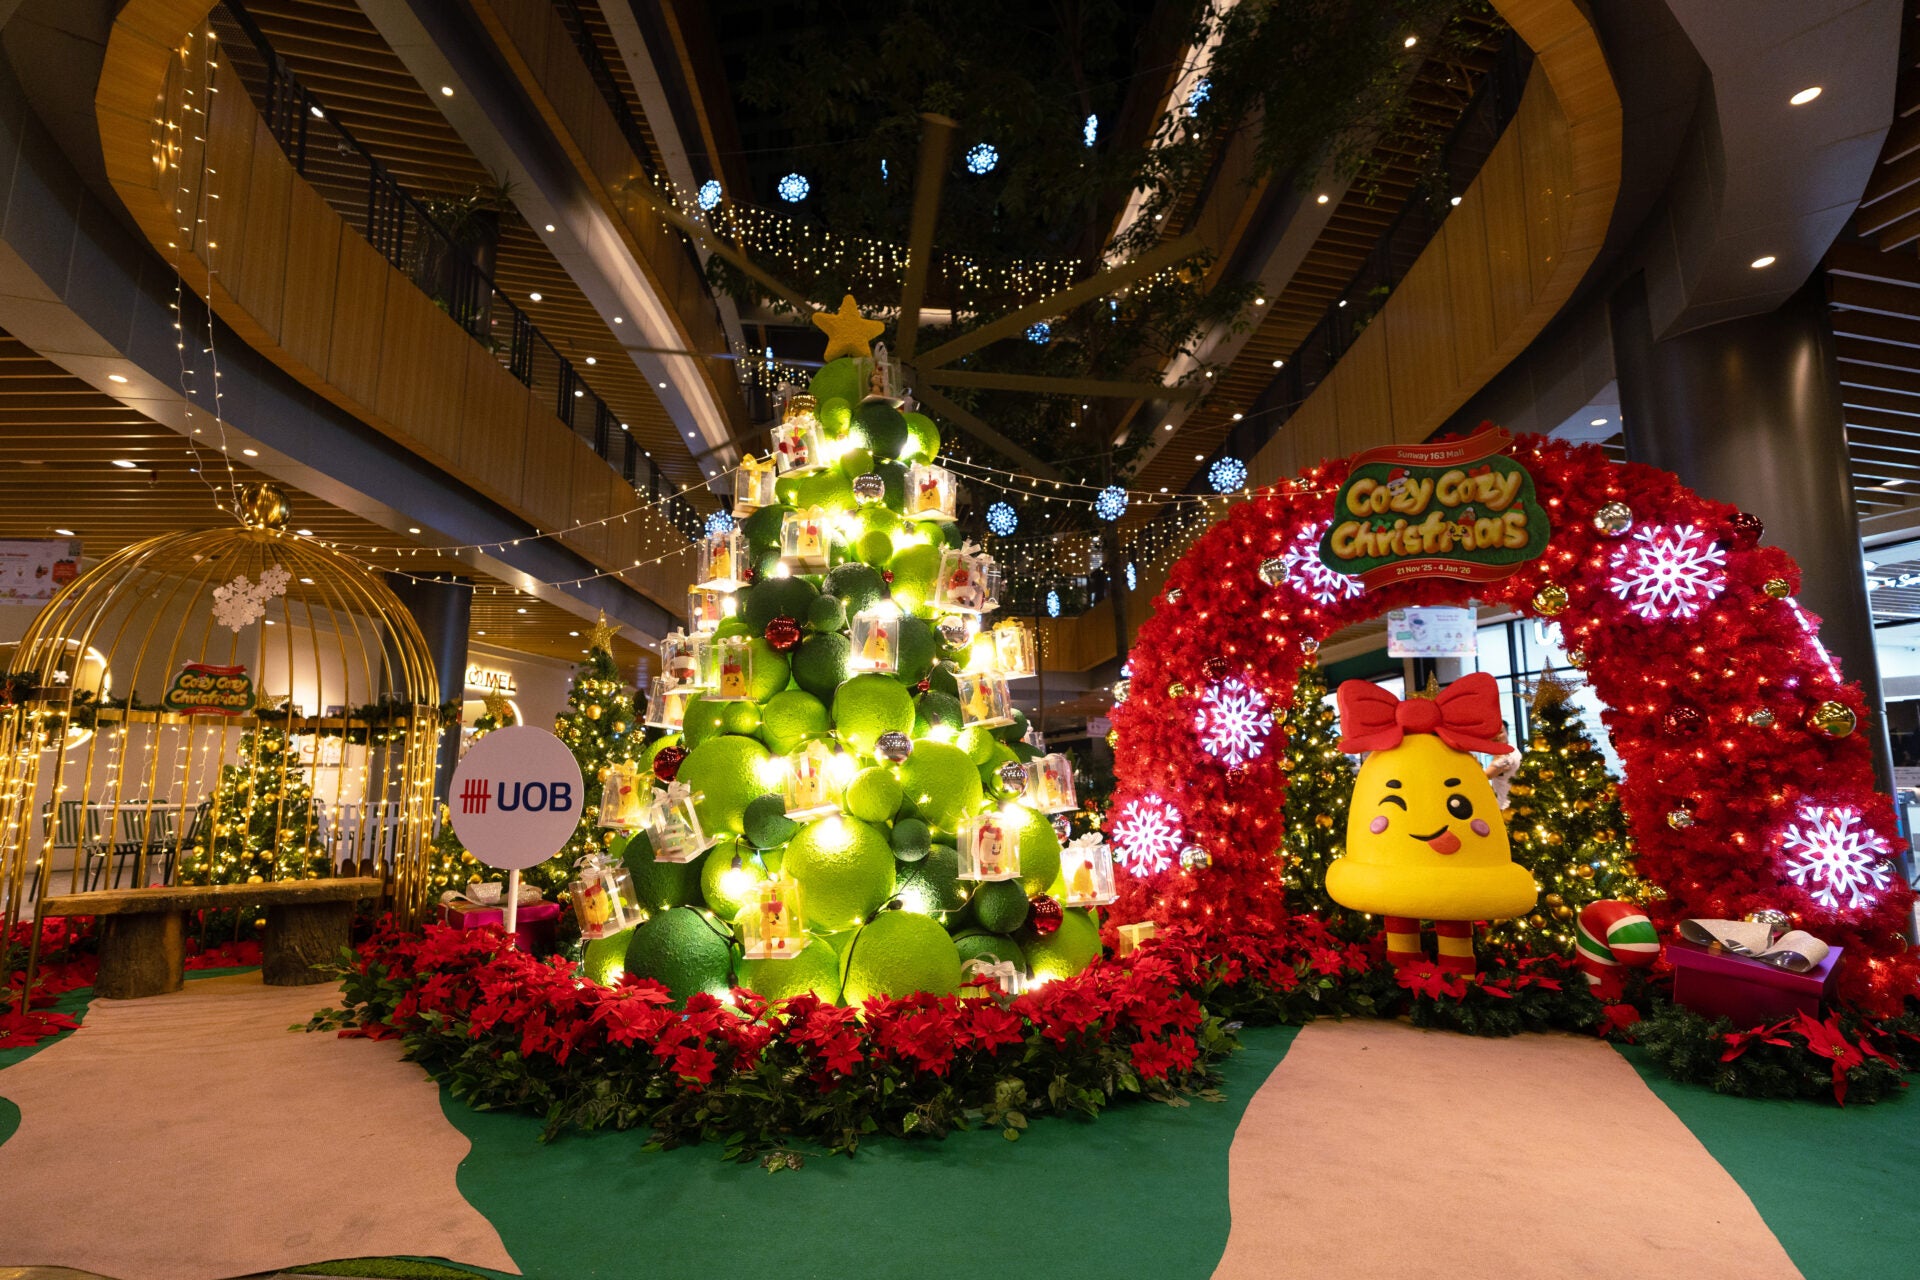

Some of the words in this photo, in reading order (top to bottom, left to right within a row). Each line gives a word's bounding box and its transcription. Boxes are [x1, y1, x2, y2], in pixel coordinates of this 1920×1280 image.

[1397, 450, 1429, 461] Sunway
[1430, 451, 1446, 460] 163
[1446, 448, 1465, 458] Mall
[1346, 477, 1434, 517] Cozy
[1436, 470, 1523, 511] Cozy
[1331, 511, 1529, 560] Christmas
[1396, 567, 1405, 575] 21
[1405, 565, 1421, 573] Nov
[1444, 564, 1458, 572] Jan
[180, 674, 215, 690] Cozy
[216, 677, 248, 692] Cozy
[170, 689, 247, 706] Christmas
[497, 781, 573, 812] UOB
